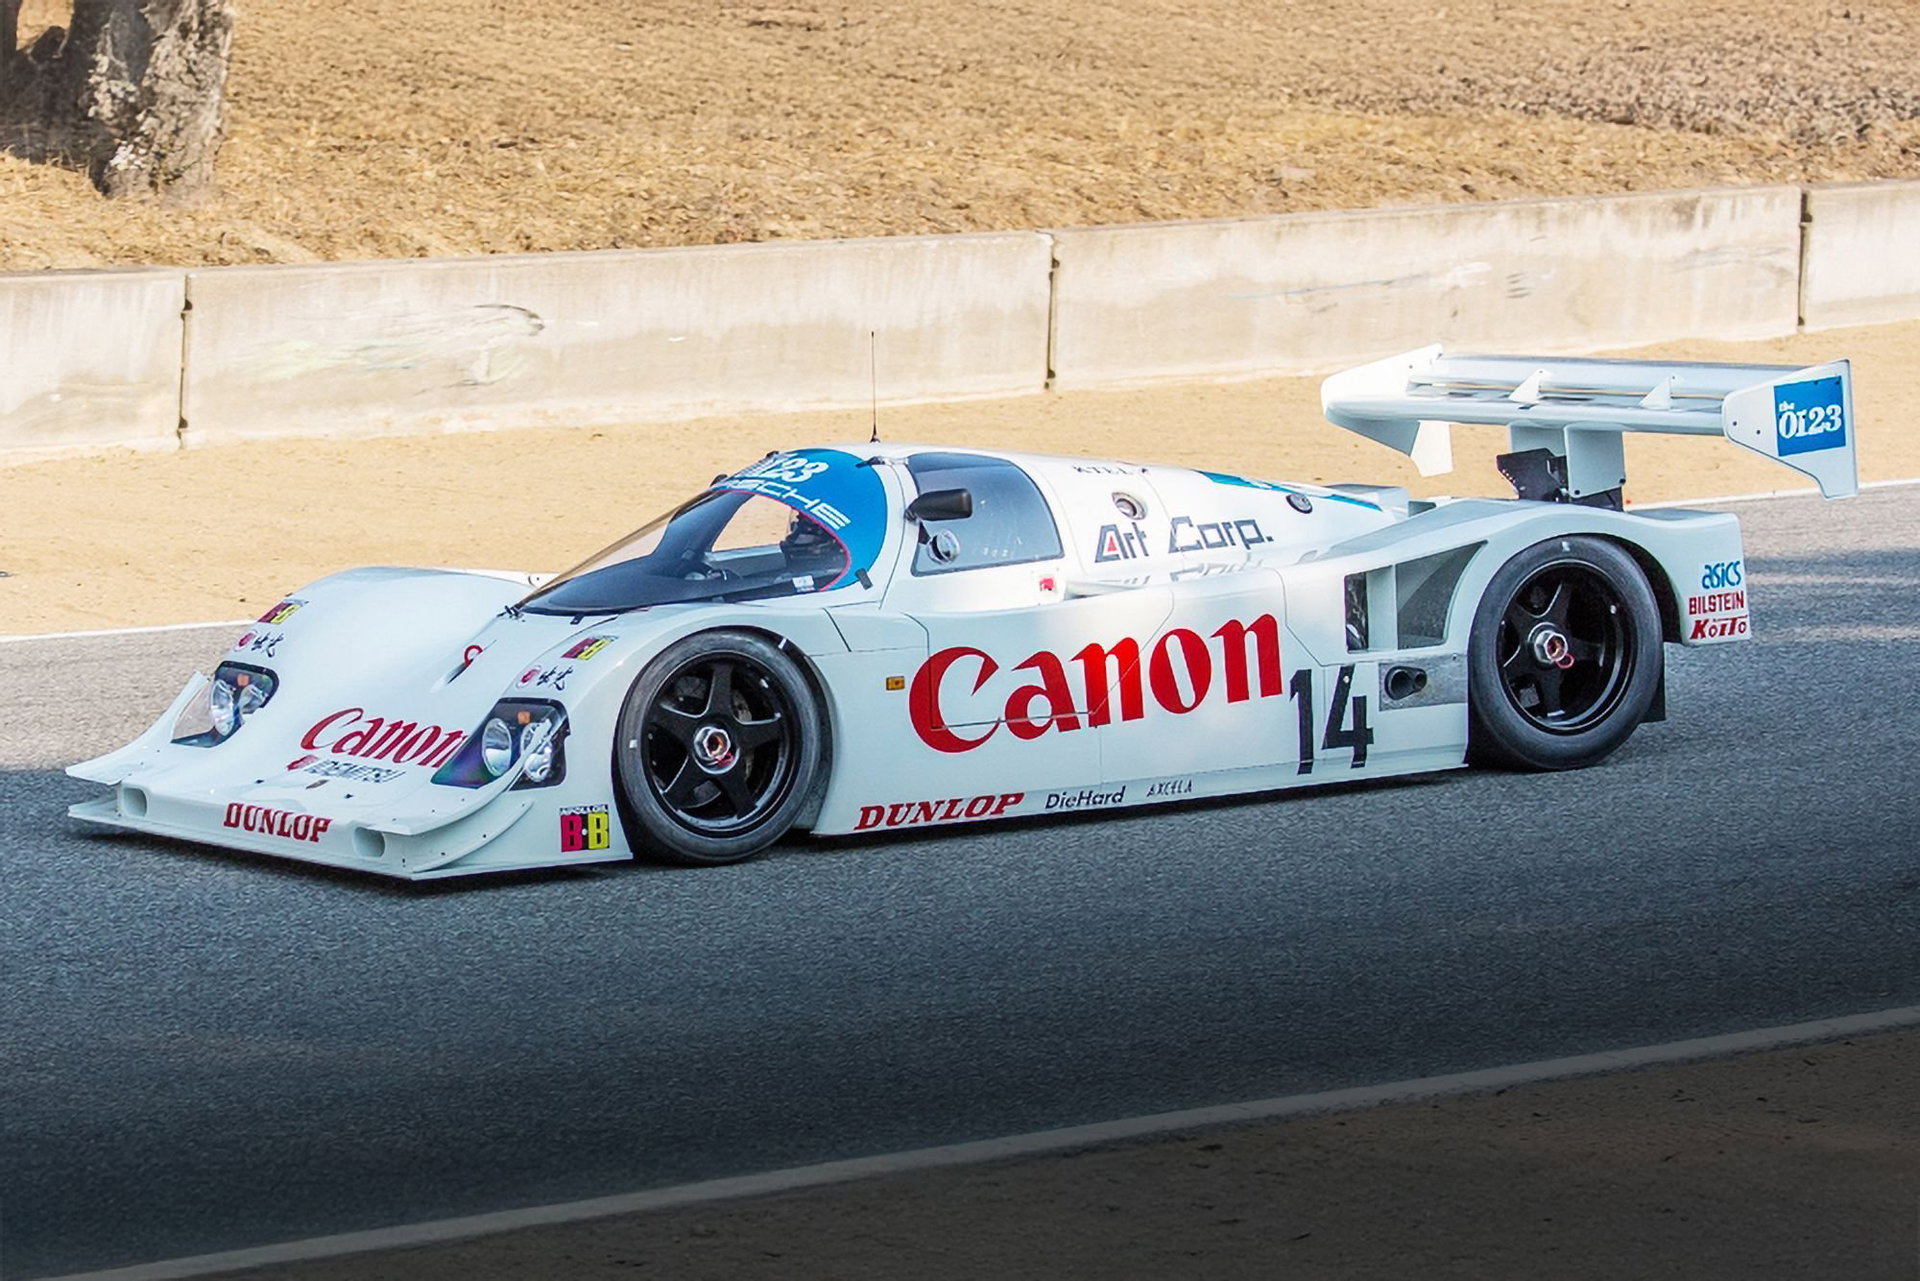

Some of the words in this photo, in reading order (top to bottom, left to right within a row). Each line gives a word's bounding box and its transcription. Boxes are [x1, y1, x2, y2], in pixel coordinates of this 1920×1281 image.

[1094, 521, 1149, 563] Art
[1167, 515, 1274, 555] Corp.
[1701, 560, 1742, 589] asics
[1688, 590, 1745, 615] BILSTEIN
[908, 613, 1283, 754] Canon
[300, 707, 468, 768] Canon
[1289, 663, 1375, 776] 14
[853, 791, 1026, 831] DUNLOP
[1045, 784, 1126, 809] DieHard
[223, 802, 333, 843] DUNLOP
